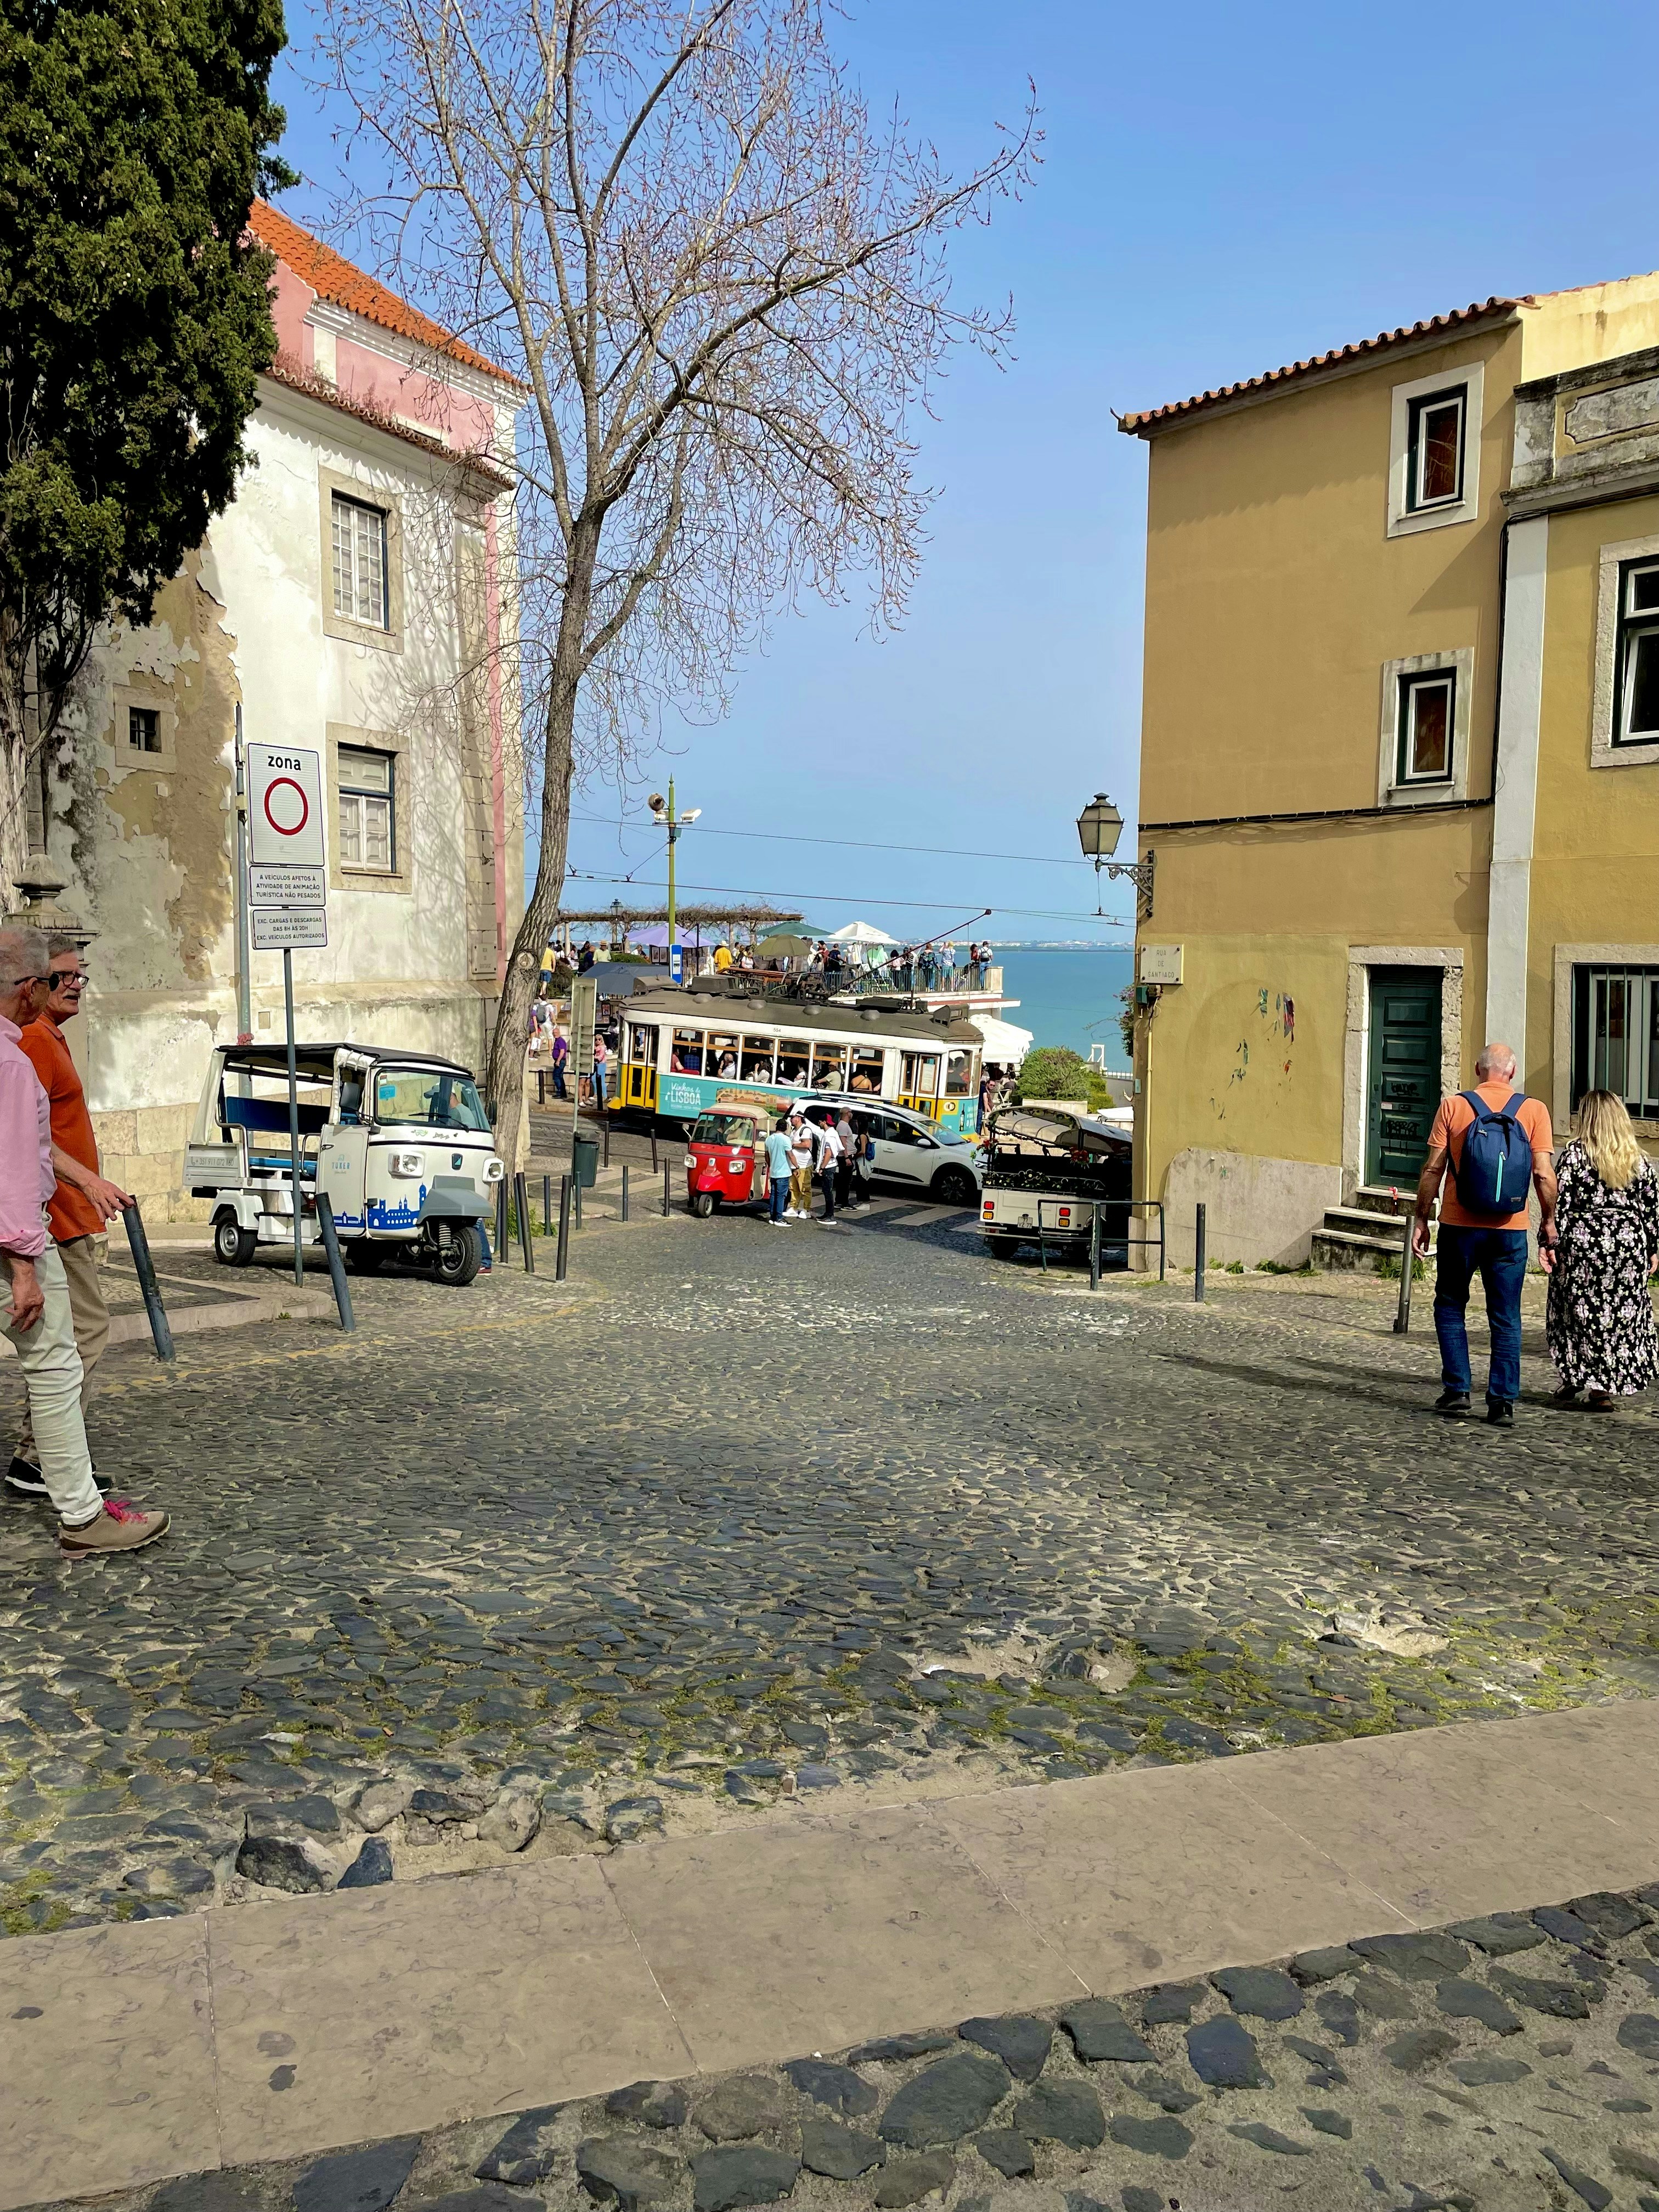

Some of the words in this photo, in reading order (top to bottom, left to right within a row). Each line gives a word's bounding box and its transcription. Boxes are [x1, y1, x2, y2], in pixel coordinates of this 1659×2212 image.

[268, 755, 301, 771] zona
[671, 1082, 695, 1092] Vinhos
[671, 1091, 701, 1105] LISBOA
